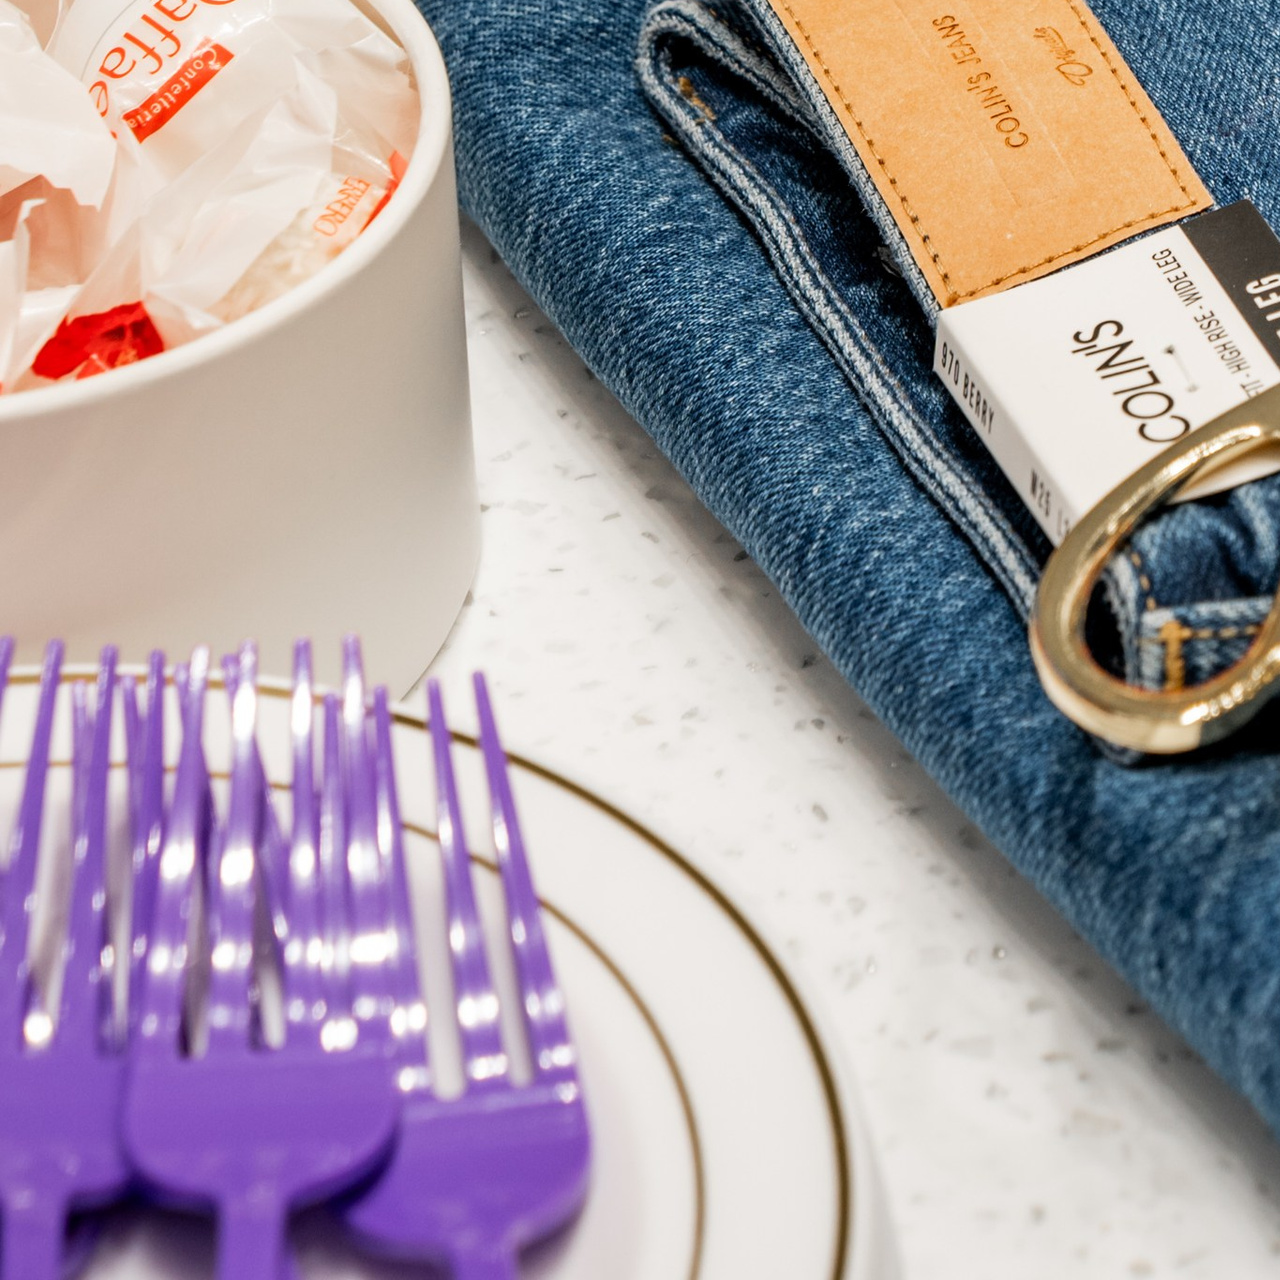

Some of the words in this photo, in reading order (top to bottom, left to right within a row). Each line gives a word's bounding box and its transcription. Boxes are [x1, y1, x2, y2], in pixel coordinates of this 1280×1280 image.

[932, 15, 982, 65] JEANS
[128, 46, 222, 128] Confetteria
[967, 72, 1029, 148] COLIN'S
[1152, 248, 1181, 274] LEG
[1167, 271, 1203, 307] WIDE
[1194, 309, 1228, 343] RISE
[1071, 320, 1191, 442] COLIN'S
[1215, 341, 1251, 374] HIGH
[940, 341, 960, 386] 970
[962, 372, 994, 434] BERRY
